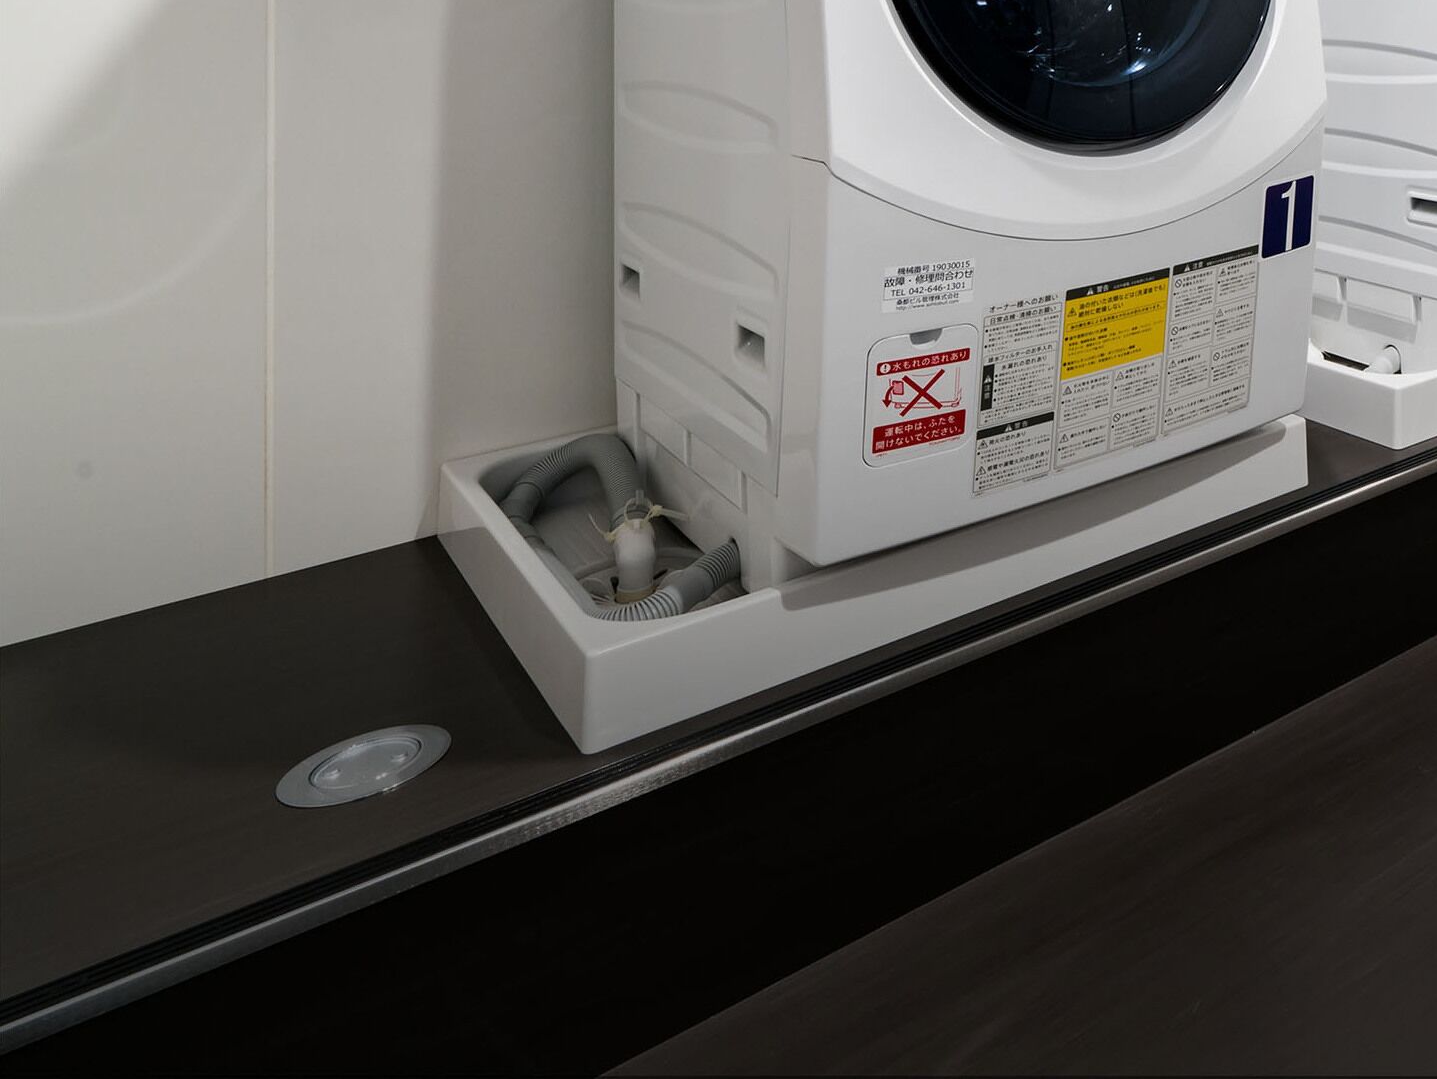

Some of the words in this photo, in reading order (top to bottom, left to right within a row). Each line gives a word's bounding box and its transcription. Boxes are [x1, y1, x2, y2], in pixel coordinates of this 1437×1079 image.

[1281, 180, 1297, 252] 1
[932, 260, 971, 272] 19030015
[884, 269, 974, 288] 故障・修理問合わせ
[891, 289, 906, 297] TEL
[908, 281, 966, 295] 042-646-1301
[893, 351, 967, 371] 水もれの恐れあり
[885, 416, 956, 437] 運転中は、ふたを
[875, 426, 962, 451] 開けないでください。
